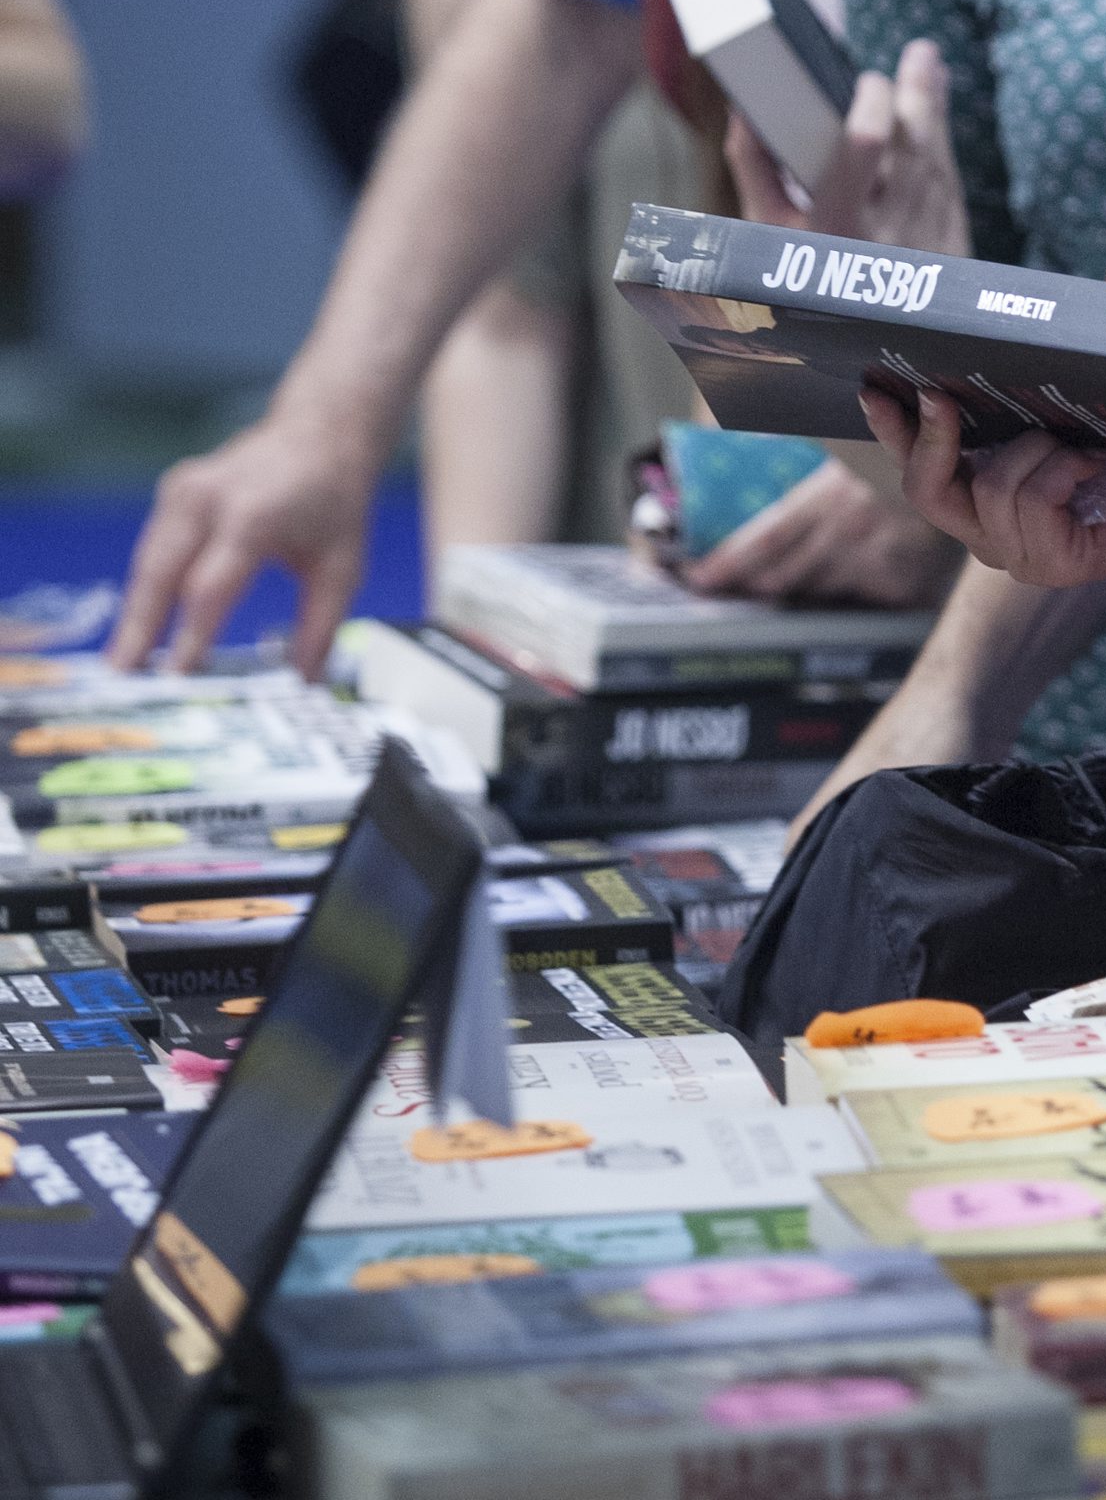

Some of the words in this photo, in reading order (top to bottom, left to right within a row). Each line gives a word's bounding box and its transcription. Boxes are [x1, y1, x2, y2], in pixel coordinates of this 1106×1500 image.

[762, 242, 816, 292] JO
[816, 249, 943, 313] NESBØ
[976, 289, 1057, 322] MACBETH
[142, 967, 258, 994] THOMAS
